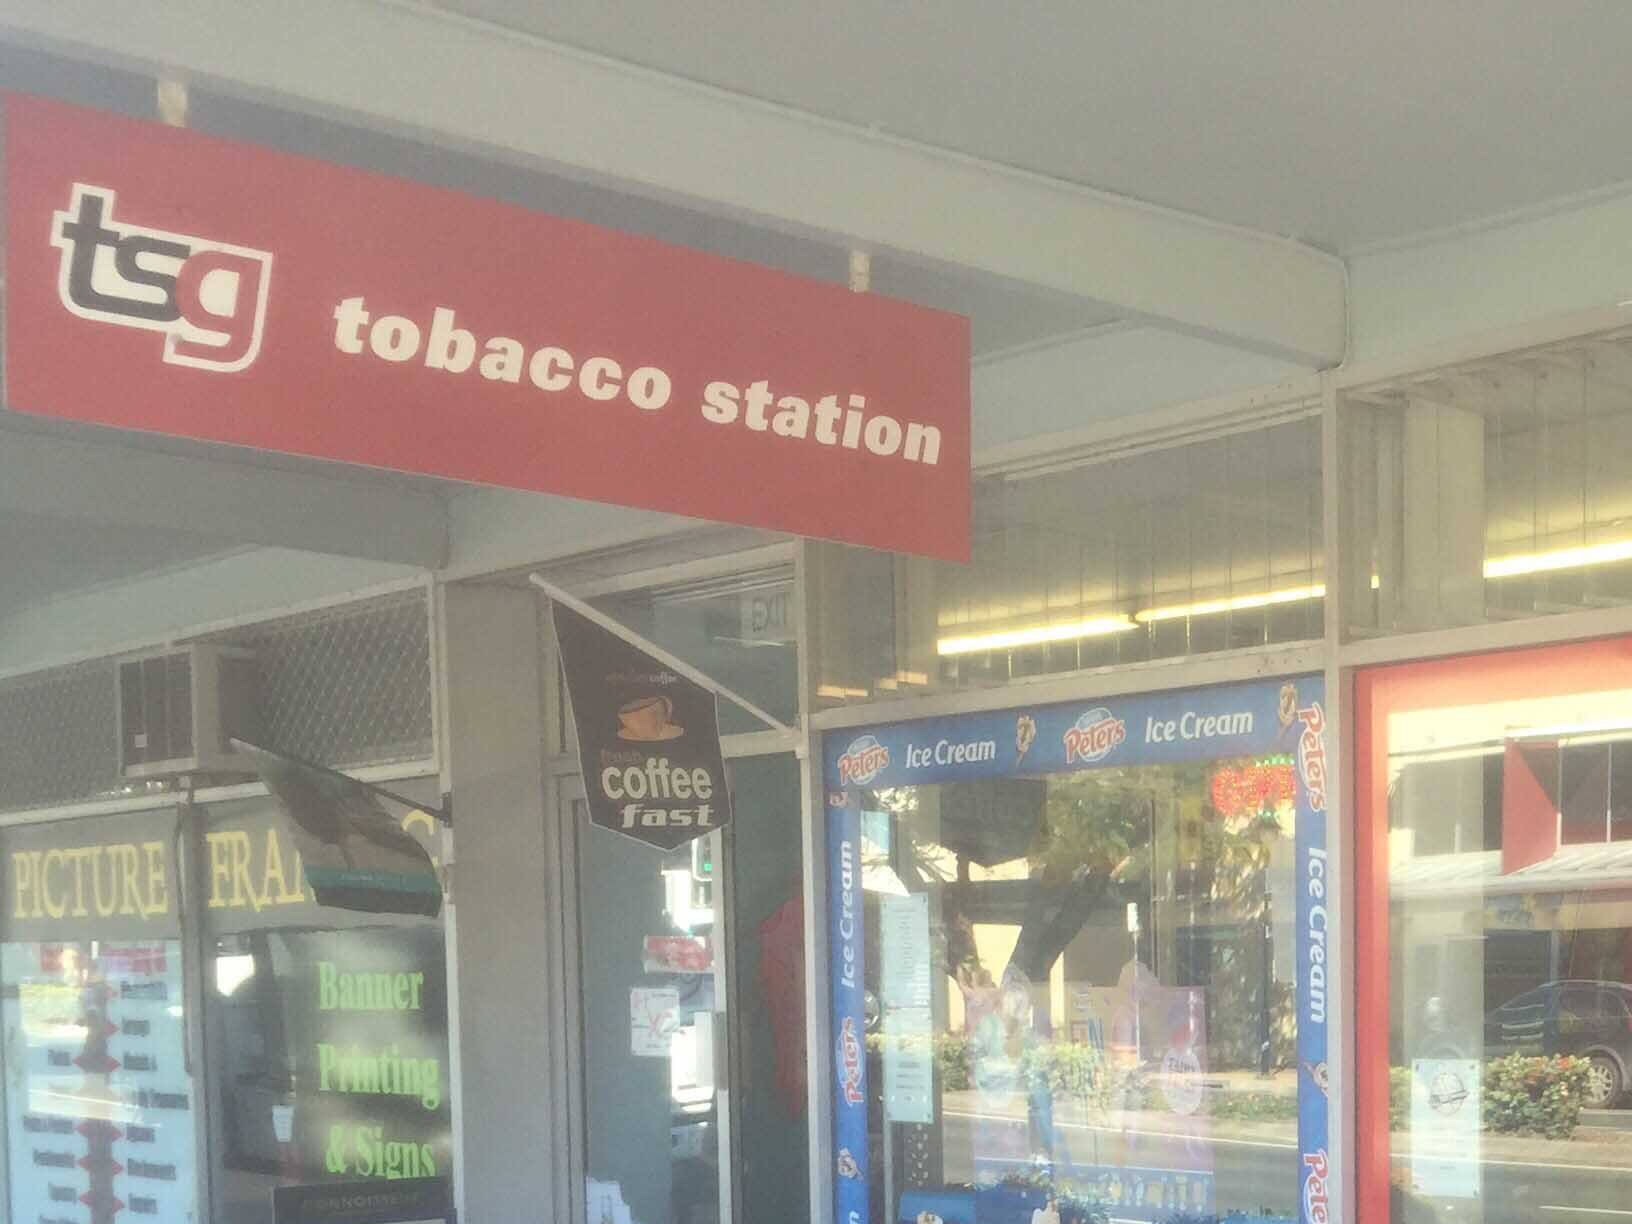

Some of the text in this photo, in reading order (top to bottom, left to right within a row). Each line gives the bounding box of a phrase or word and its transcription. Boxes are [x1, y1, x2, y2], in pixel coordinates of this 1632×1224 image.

[55, 184, 271, 370] tsg
[334, 295, 943, 466] tobacco station
[838, 739, 996, 786] Peters Ice Cream
[1064, 711, 1253, 764] Peters Ice Cream
[602, 757, 713, 800] coffee
[621, 803, 715, 829] fast
[13, 841, 168, 920] PICTURE
[1296, 701, 1328, 1024] Peters Ice Cream
[839, 840, 855, 989] Ice Cream
[318, 959, 424, 1011] Banner
[318, 1042, 440, 1109] Printing
[324, 1121, 436, 1180] & Signs
